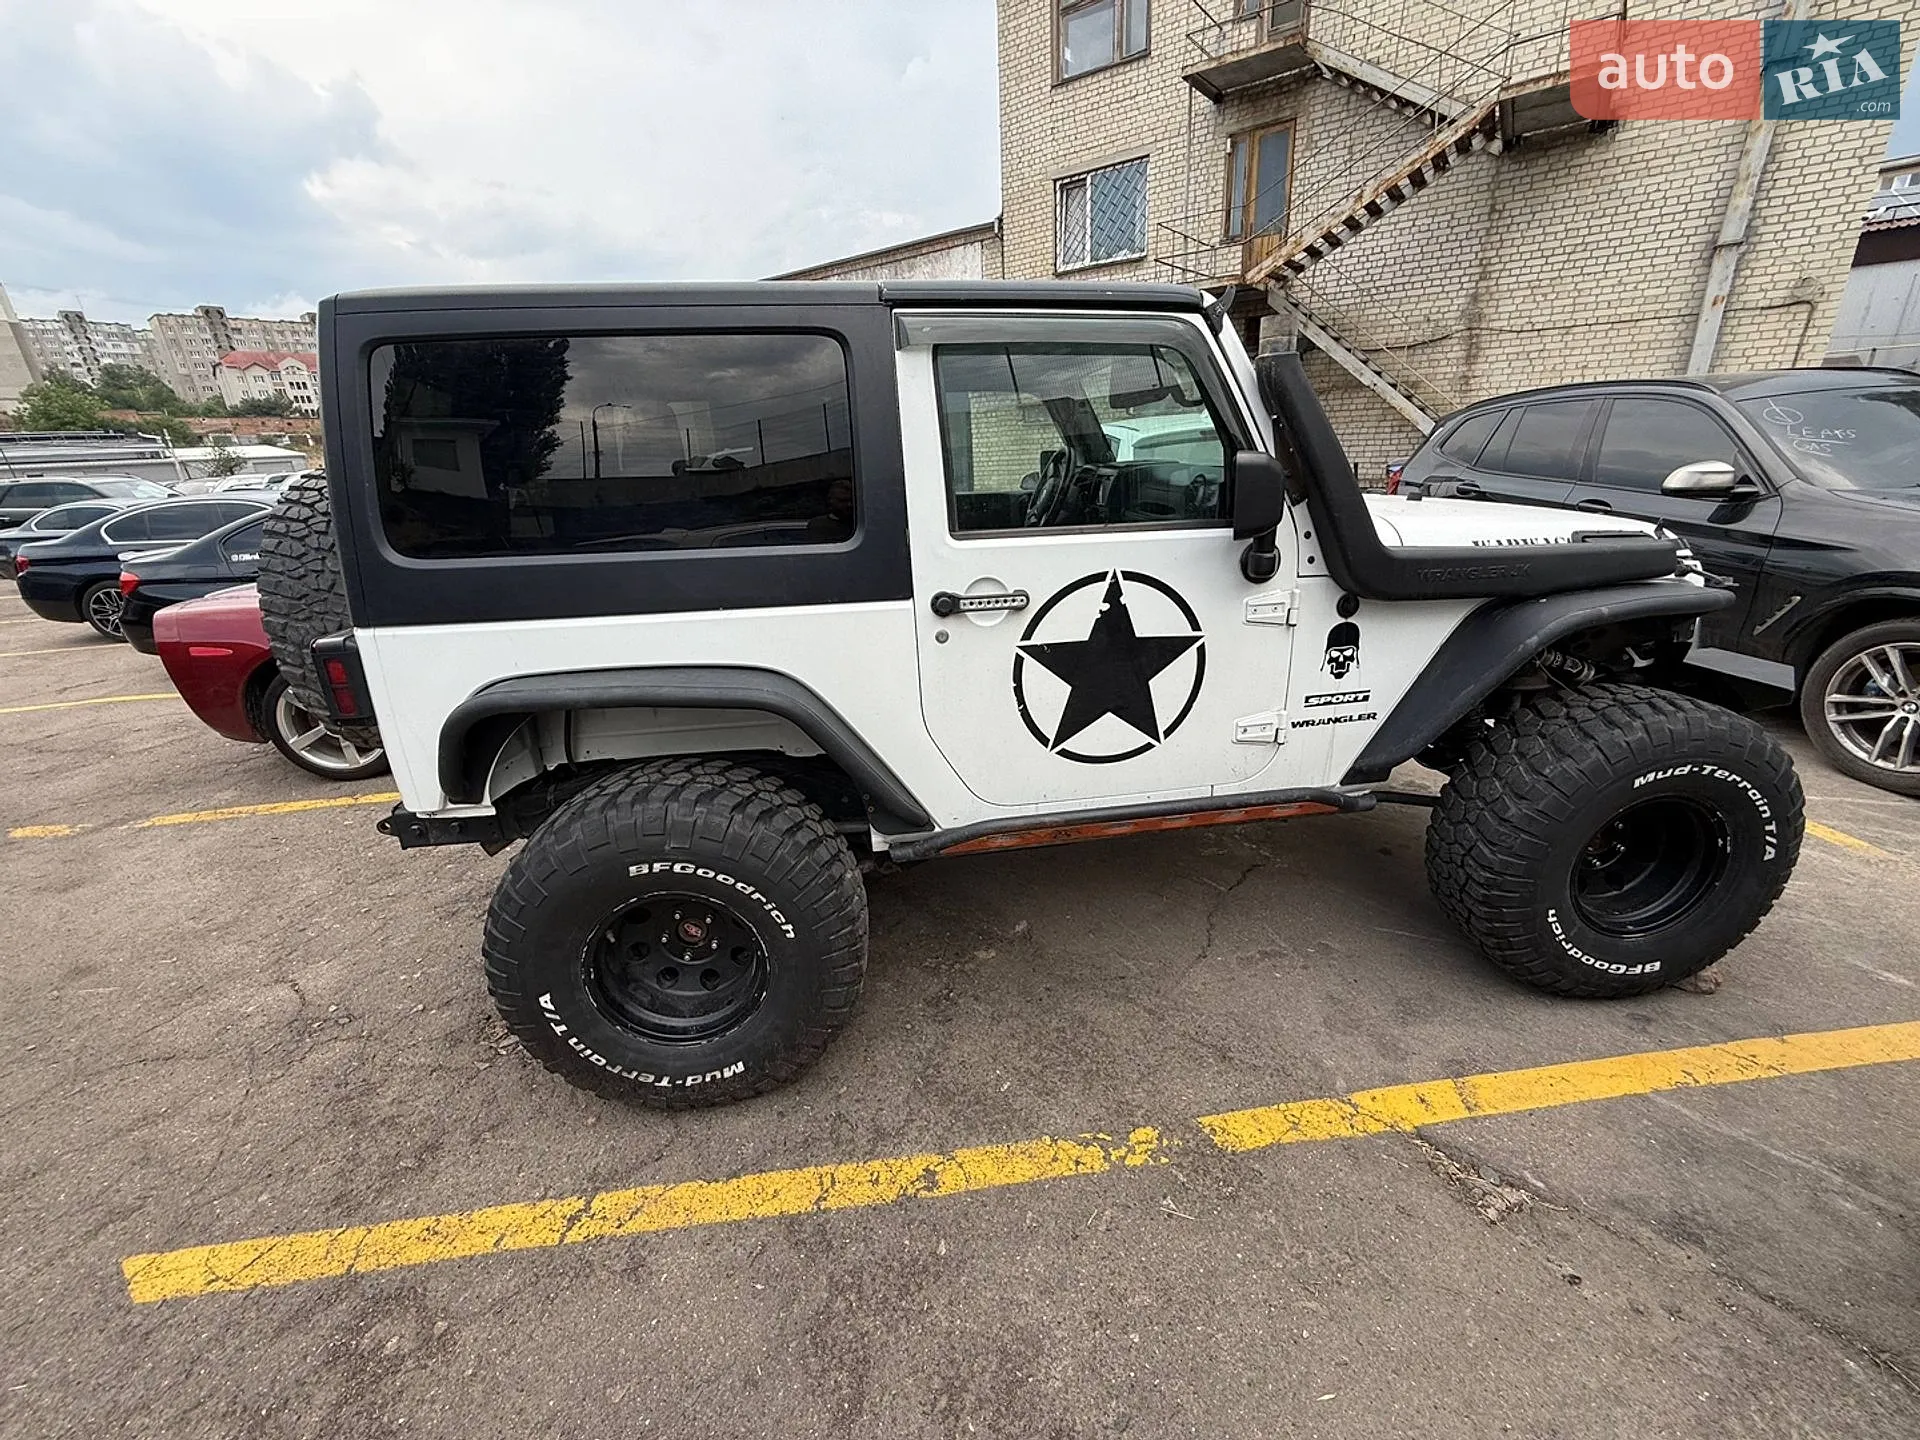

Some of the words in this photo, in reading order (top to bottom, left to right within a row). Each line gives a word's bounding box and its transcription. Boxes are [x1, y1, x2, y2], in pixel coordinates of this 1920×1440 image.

[1291, 712, 1378, 728] WRANGLER
[1308, 694, 1365, 705] SPORT
[1633, 764, 1772, 819] Mud-Terrain
[628, 862, 796, 939] BFGoodrich
[1547, 908, 1661, 975] BFGoodrich
[567, 1037, 746, 1087] Mud-Terrain
